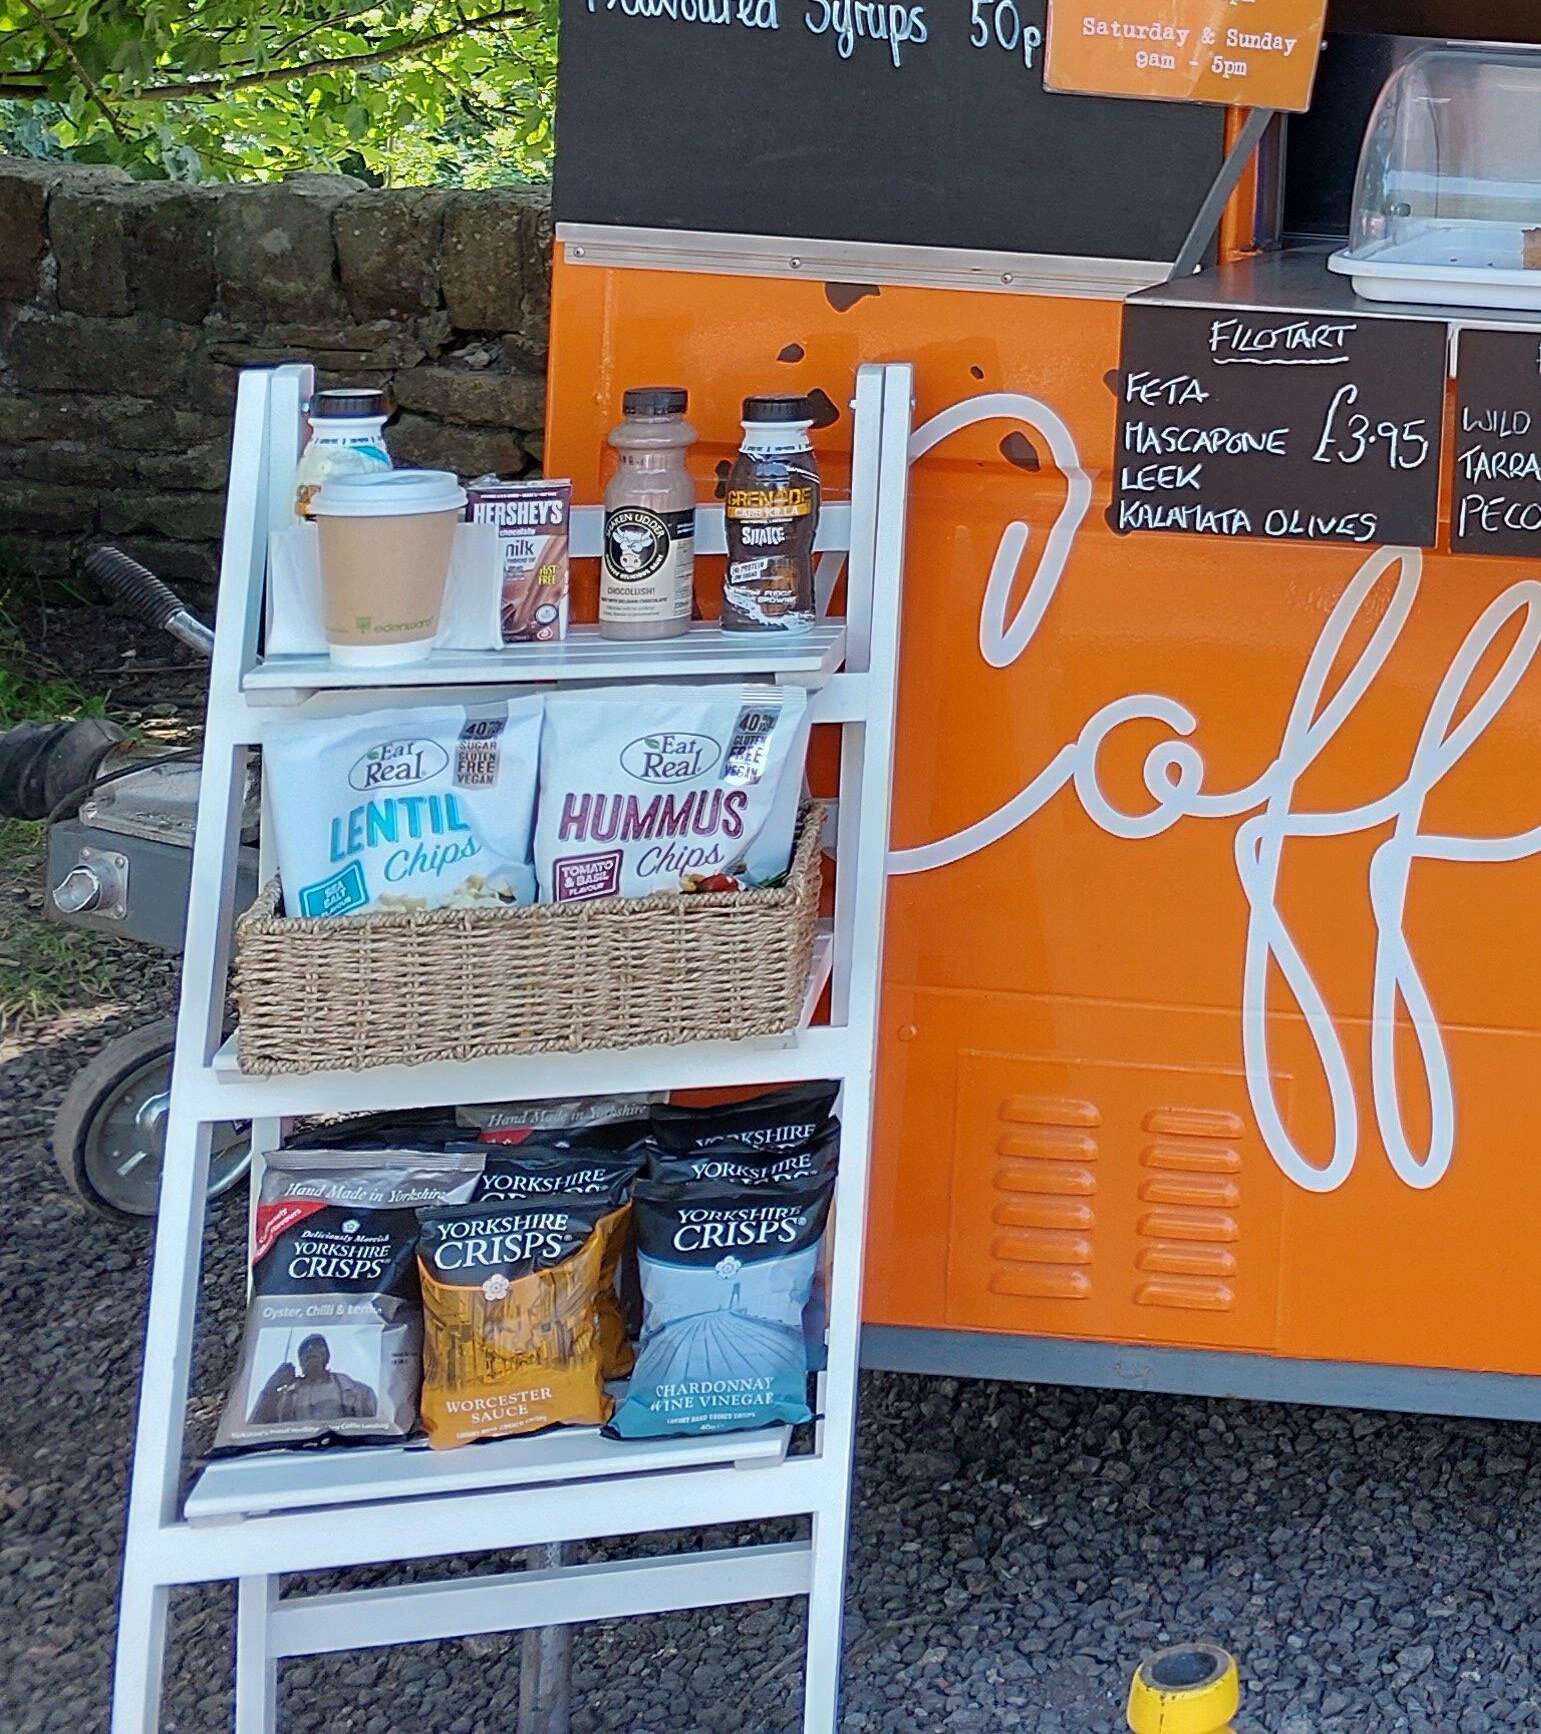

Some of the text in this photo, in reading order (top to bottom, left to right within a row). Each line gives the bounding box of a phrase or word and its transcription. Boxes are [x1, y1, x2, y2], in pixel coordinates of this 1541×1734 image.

[1083, 17, 1297, 56] Saturday Sunday
[1127, 372, 1209, 405] FETA
[1313, 384, 1428, 468] £3.95
[1122, 464, 1201, 490] LEEK
[473, 500, 563, 525] HERSHEY'S
[1120, 500, 1377, 541] KALAMATA OLIVES
[364, 761, 423, 787] Real
[642, 753, 701, 779] Real
[329, 792, 471, 862] LENTIL
[557, 789, 748, 844] HUMMUS
[384, 839, 483, 883] Chips
[635, 842, 725, 878] Chips
[437, 1214, 569, 1240] YORKSHIRE
[672, 1218, 799, 1251] CRISPS
[293, 1242, 391, 1260] YORKSHIRE
[433, 1233, 563, 1269] CRISPS
[288, 1258, 384, 1280] CRISPS
[446, 1387, 553, 1414] WORCESTER
[655, 1376, 776, 1398] CHARDONNAY
[471, 1403, 529, 1424] SAUCE
